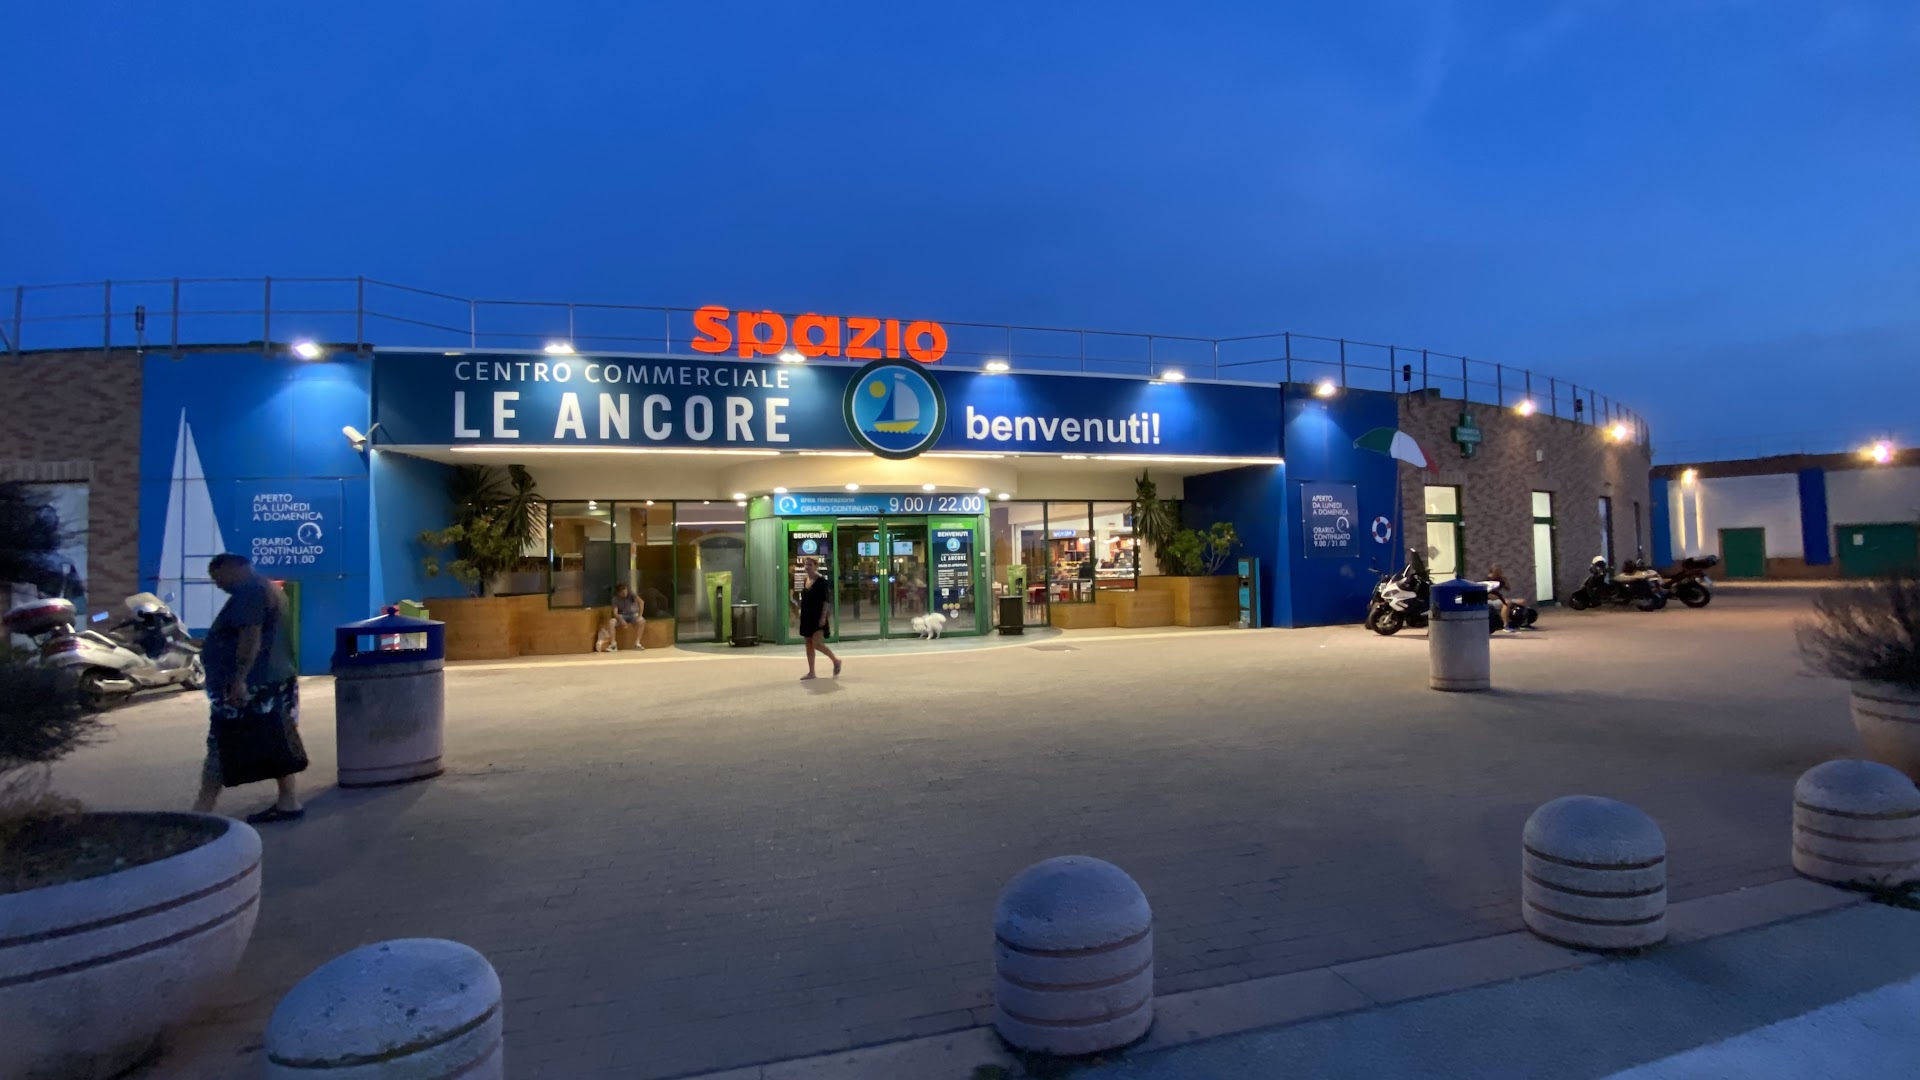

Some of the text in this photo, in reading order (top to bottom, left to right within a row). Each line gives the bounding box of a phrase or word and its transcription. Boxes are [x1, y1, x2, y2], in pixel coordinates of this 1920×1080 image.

[691, 305, 948, 363] spazio
[454, 361, 790, 389] CENTRO COMMERCIALE
[454, 391, 790, 442] LE ANCORE
[966, 405, 1160, 445] benvenuti!
[253, 494, 293, 502] APERTO
[253, 503, 268, 512] DA
[801, 505, 879, 513] ORARIO CONTINUATO
[889, 496, 981, 513] 9.00 / 22.00
[253, 512, 323, 521] A DOMENICA
[252, 537, 293, 546] ORARIO
[252, 546, 323, 555] CONTINUATO
[285, 555, 315, 564] 21.00
